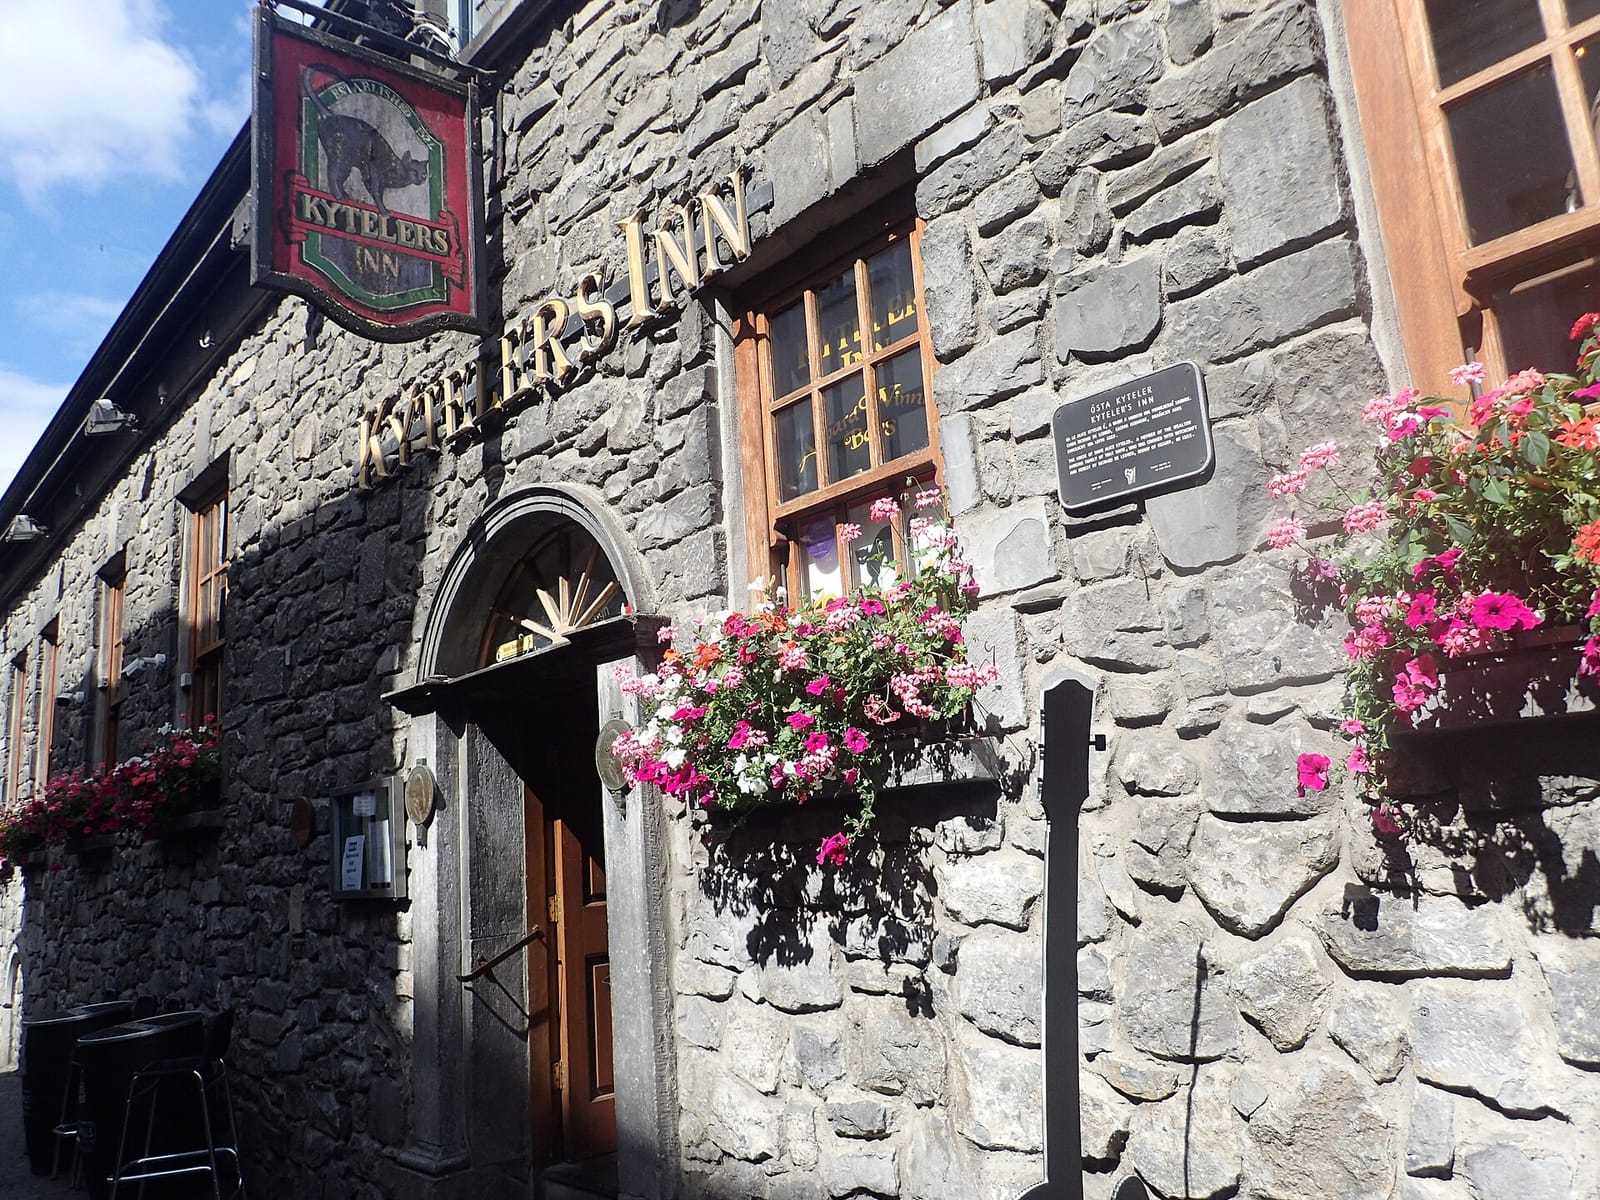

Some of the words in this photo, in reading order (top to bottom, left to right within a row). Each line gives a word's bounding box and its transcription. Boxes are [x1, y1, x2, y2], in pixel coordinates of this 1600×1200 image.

[303, 194, 450, 254] KYTELERS
[355, 246, 399, 278] INN
[616, 165, 752, 330] INN
[1090, 403, 1132, 424] KYTELER'S
[1137, 395, 1154, 407] INN
[1115, 386, 1152, 404] KYTELER
